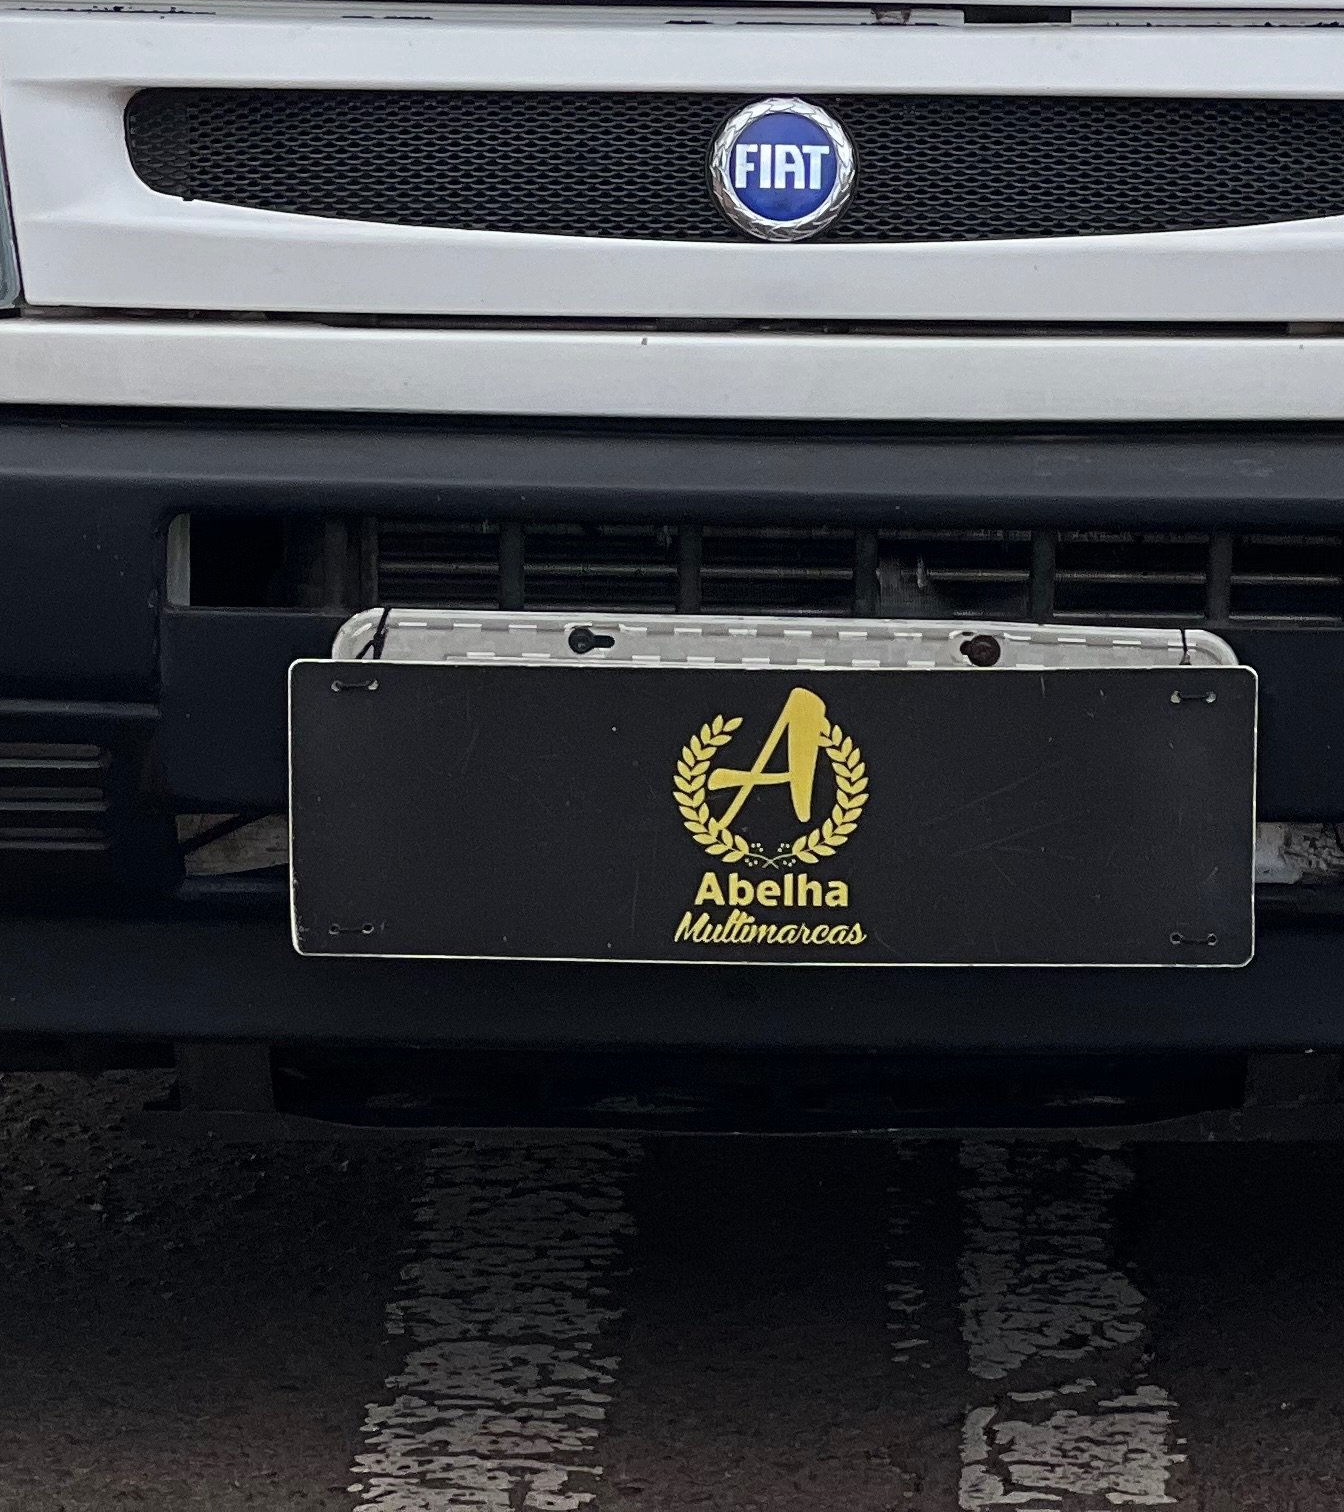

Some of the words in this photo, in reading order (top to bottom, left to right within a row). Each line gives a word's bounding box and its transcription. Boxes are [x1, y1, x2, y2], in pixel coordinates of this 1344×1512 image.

[735, 144, 830, 190] FIAT
[694, 871, 849, 907] Abelha
[674, 908, 867, 945] Multimarcas
